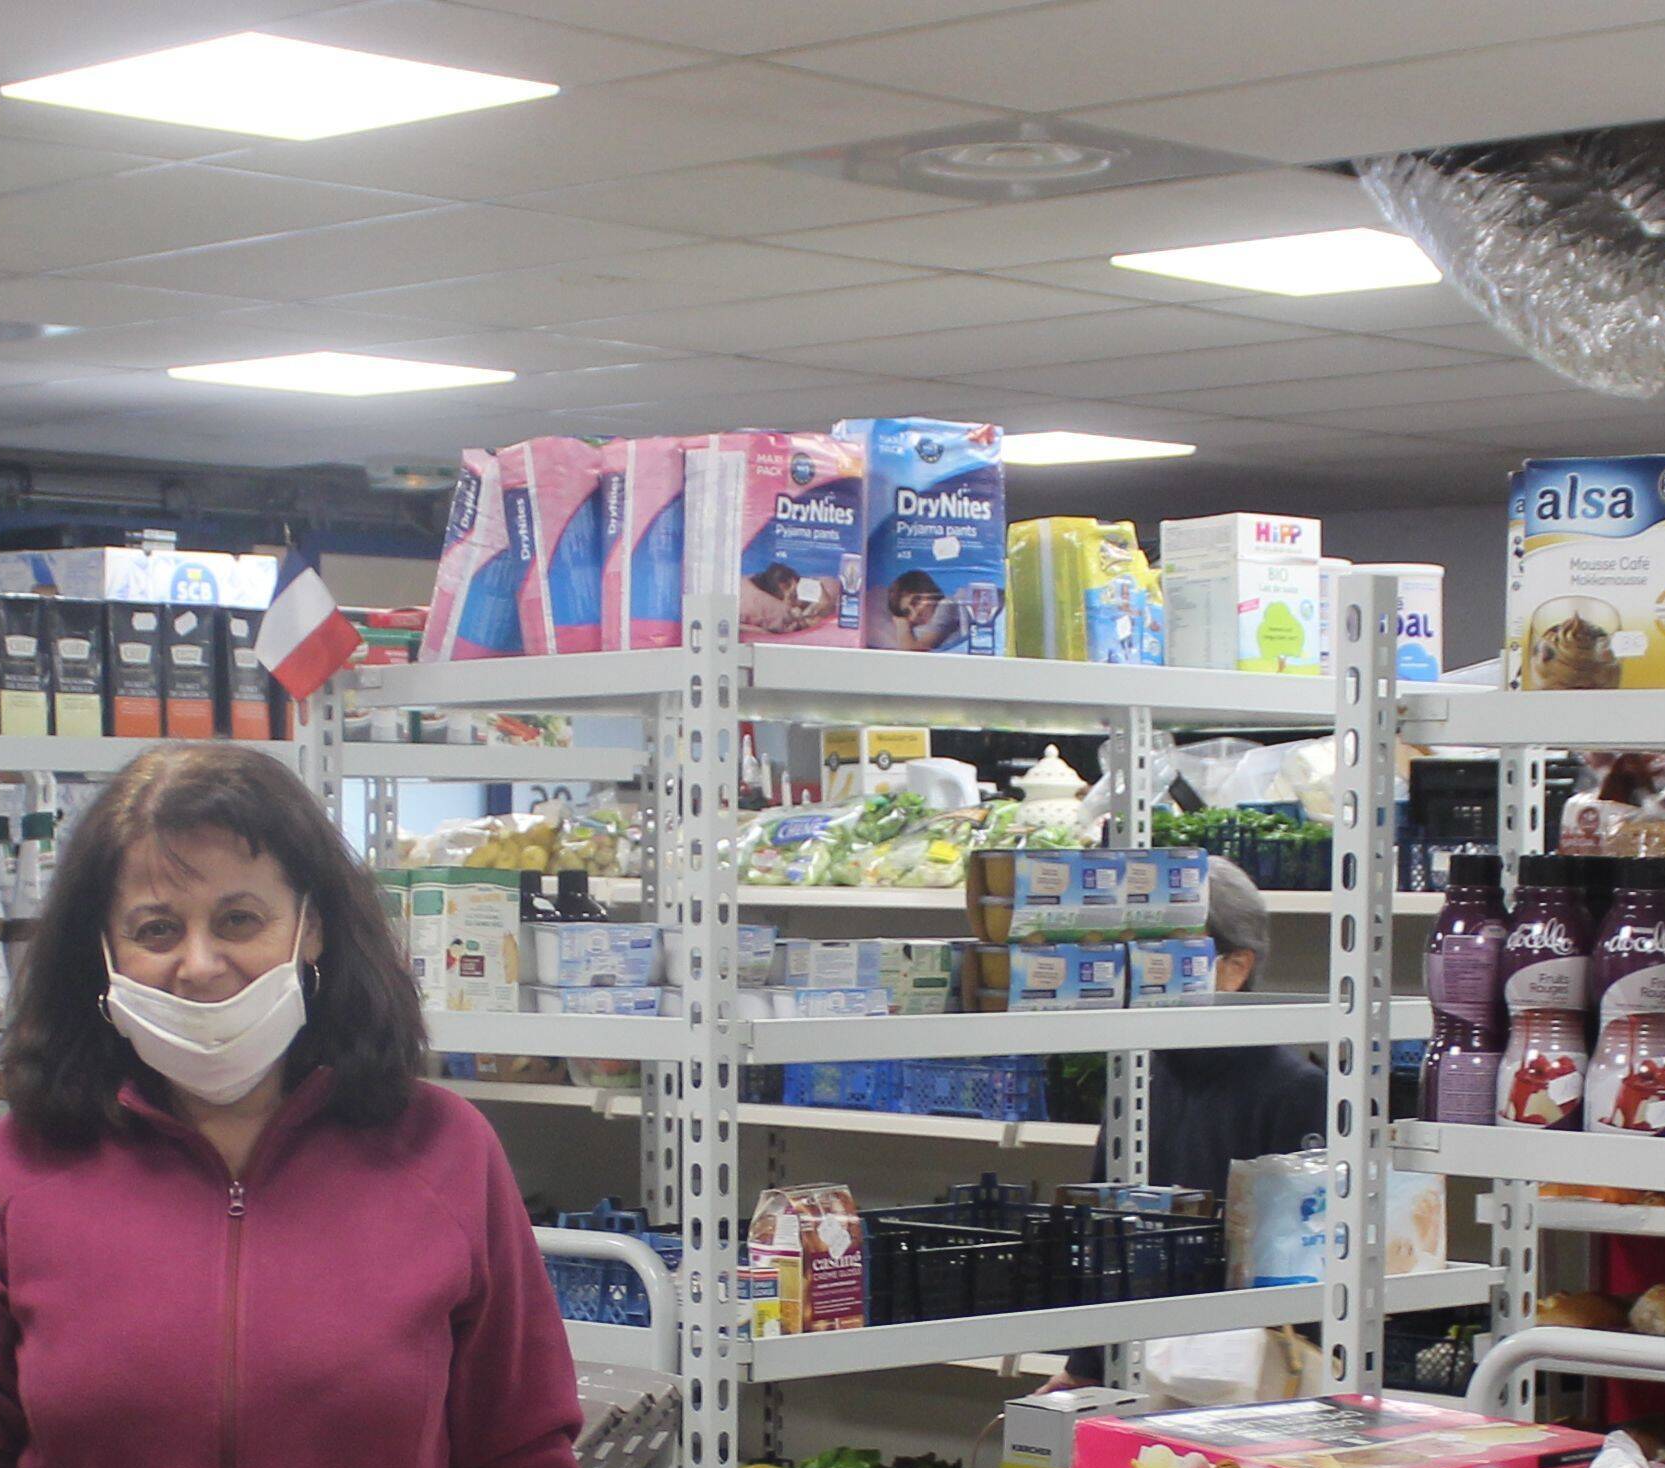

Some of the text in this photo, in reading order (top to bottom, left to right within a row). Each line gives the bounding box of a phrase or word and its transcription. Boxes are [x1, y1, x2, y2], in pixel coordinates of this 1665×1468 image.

[757, 454, 783, 464] MAXI
[757, 465, 783, 476] PACK
[897, 489, 992, 520] DryNites
[1537, 473, 1636, 520] alsa
[776, 494, 855, 525] DryNites
[516, 497, 531, 560] DryNites
[775, 523, 840, 541] Pyjama pants
[896, 521, 977, 540] Pyjama pants
[1255, 521, 1302, 545] HiPP
[1569, 555, 1650, 571] Mousse Café
[1268, 567, 1288, 580] BIO
[175, 580, 213, 600] SCB
[1539, 973, 1569, 985] Fruits
[1528, 983, 1568, 996] Rouges
